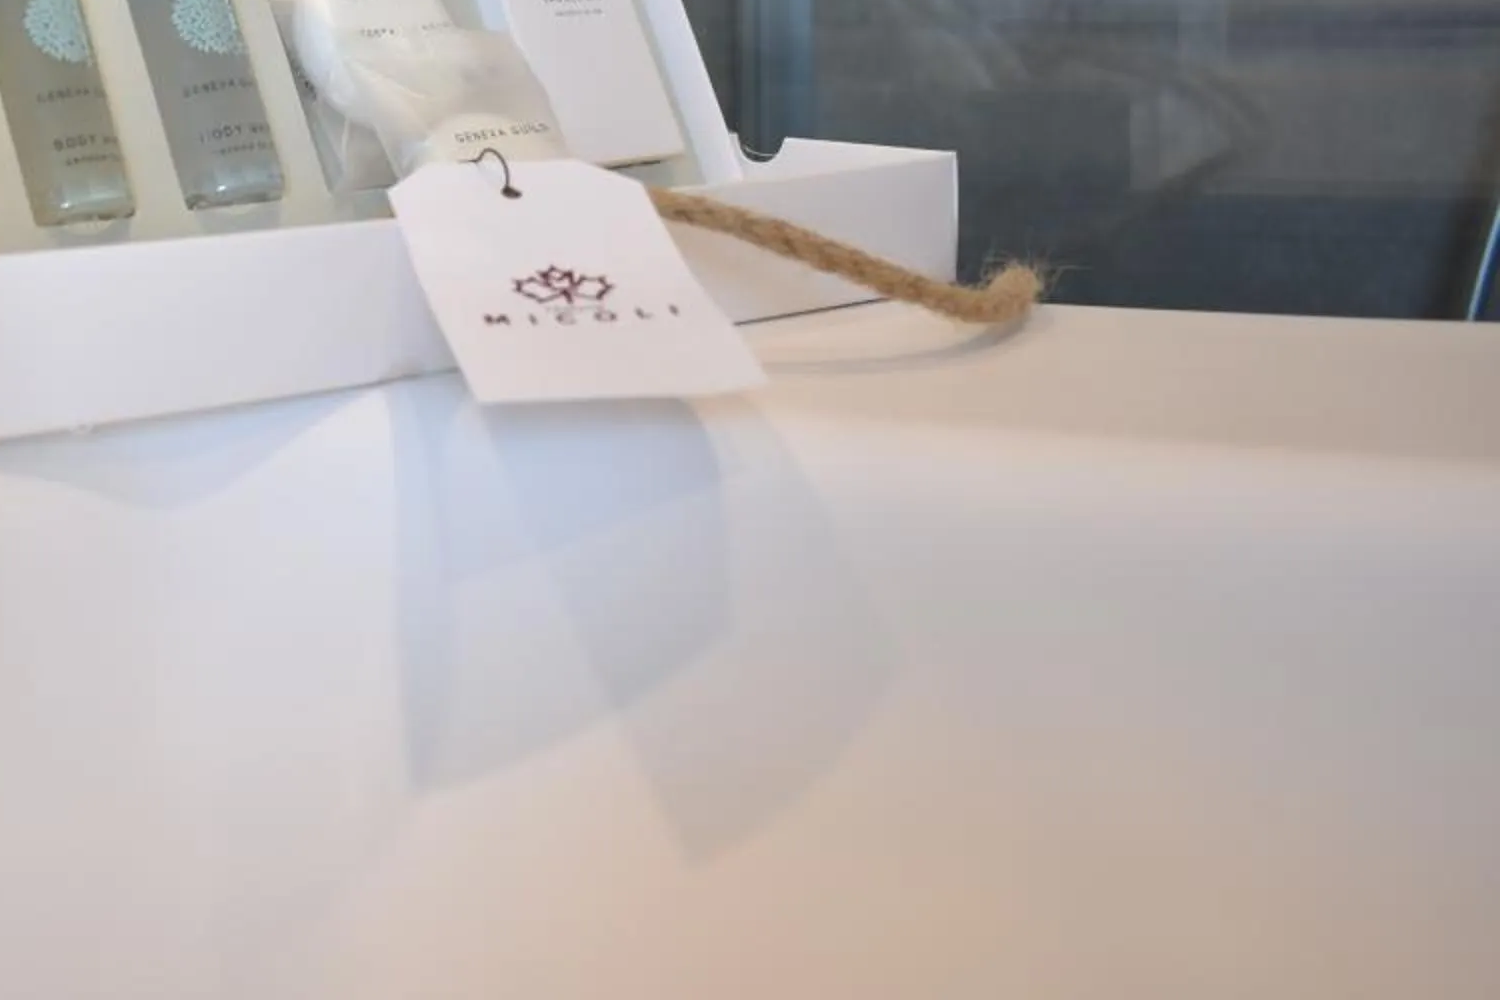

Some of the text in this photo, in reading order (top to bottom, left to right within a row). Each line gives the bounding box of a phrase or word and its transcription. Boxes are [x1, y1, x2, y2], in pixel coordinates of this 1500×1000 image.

[52, 133, 97, 152] BODY
[454, 128, 507, 144] GENEVA
[483, 304, 680, 327] MICOLI
